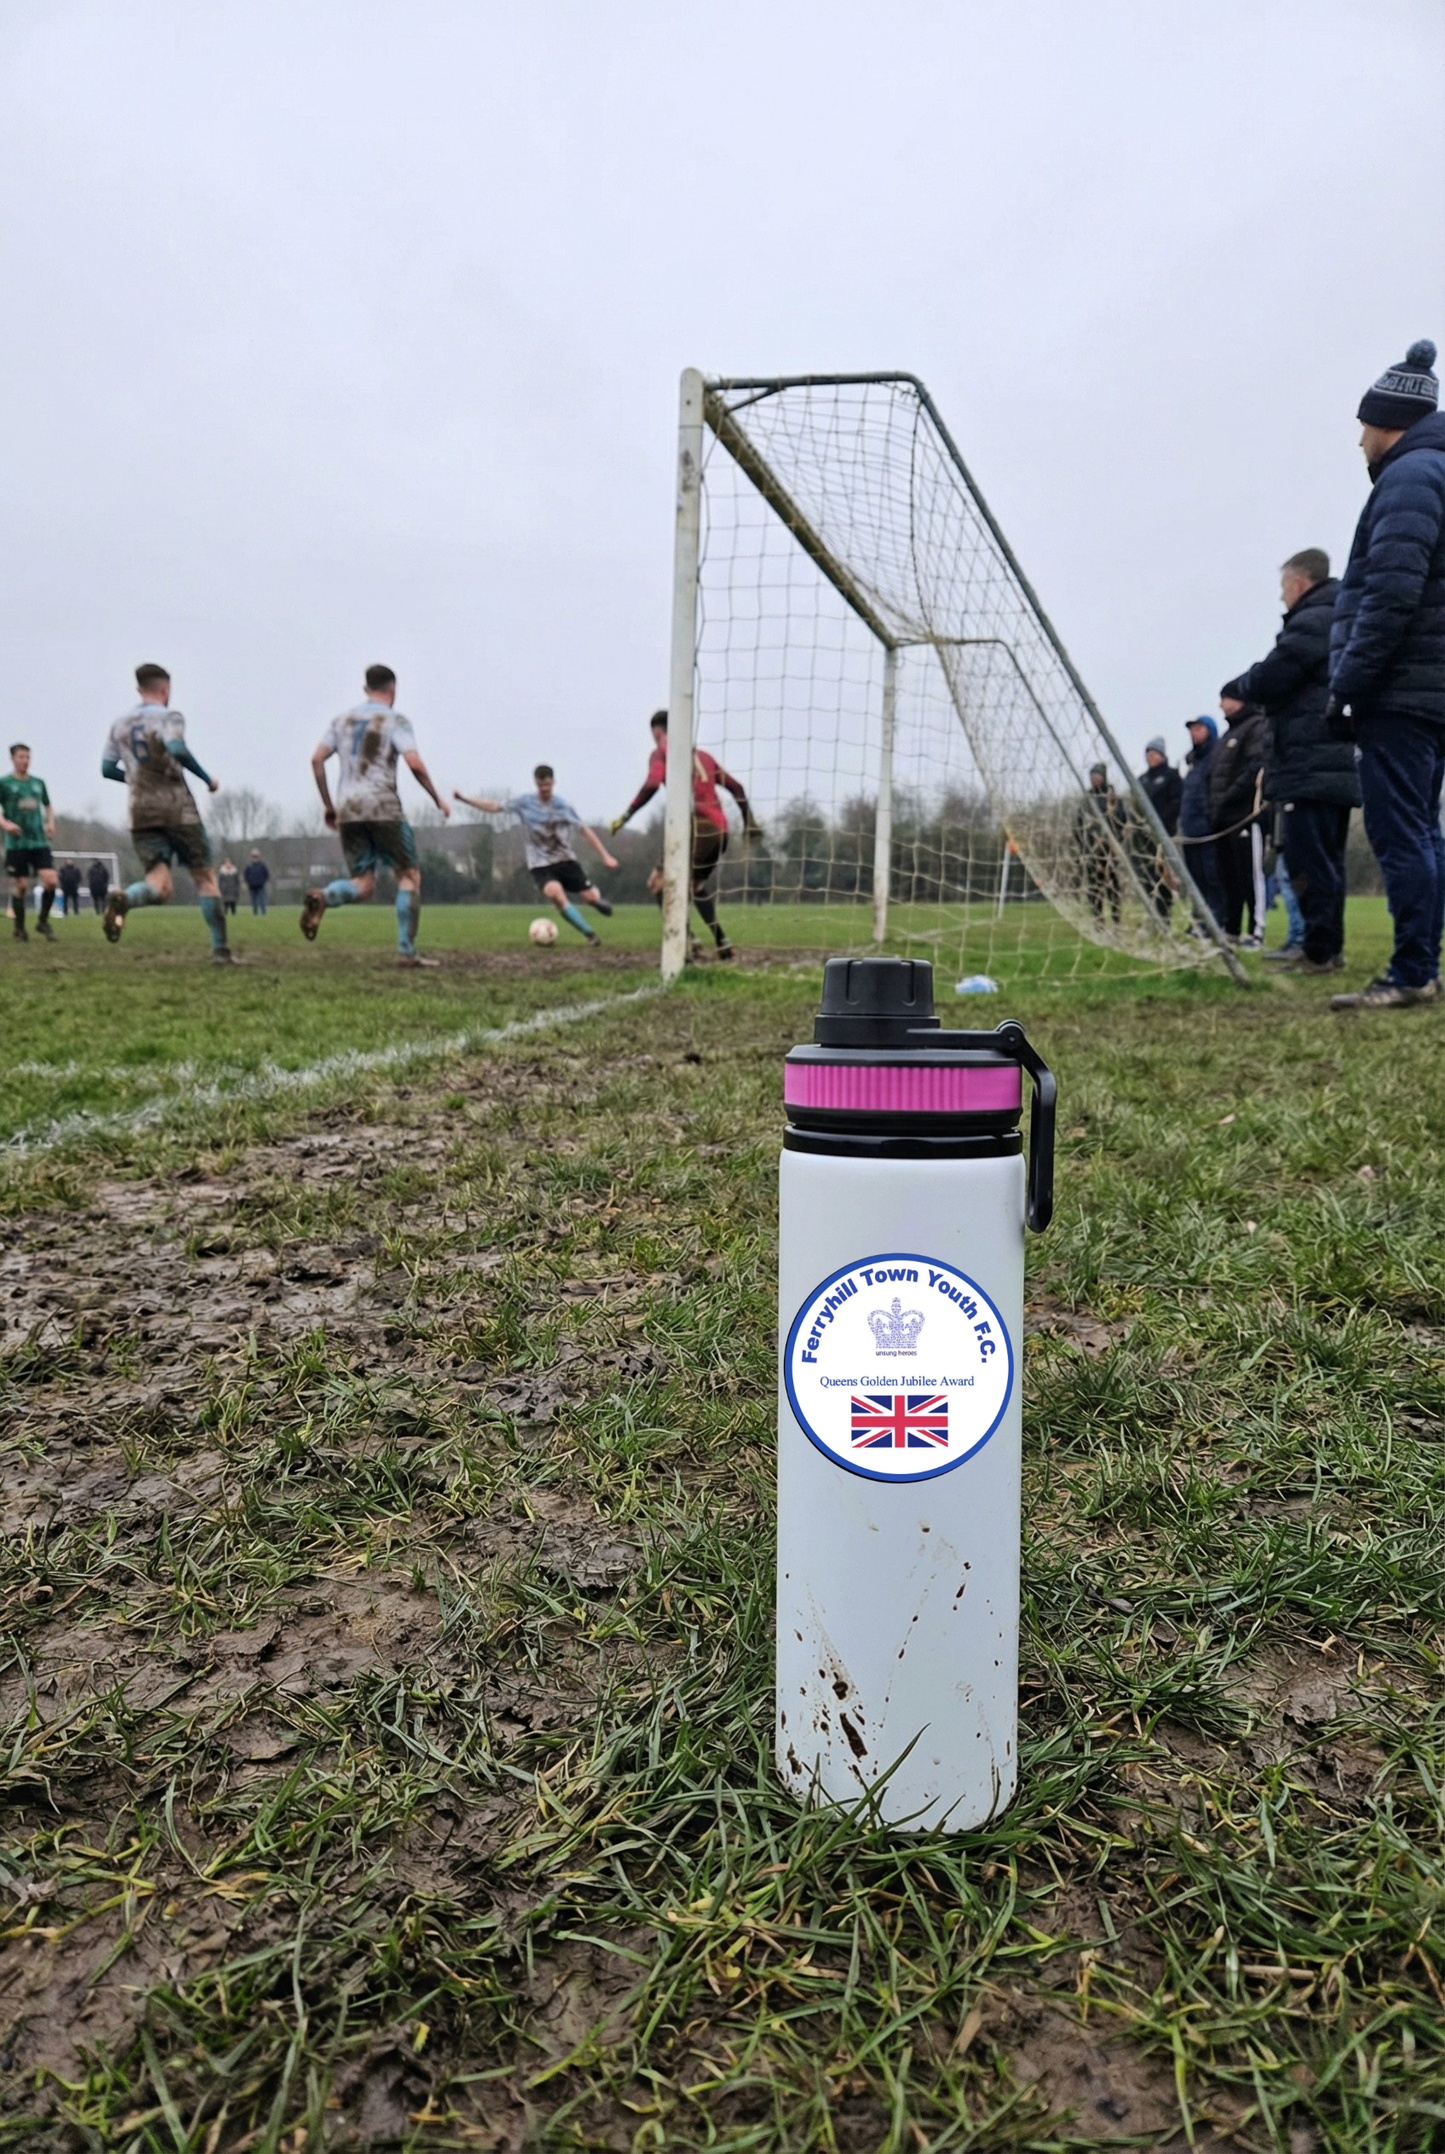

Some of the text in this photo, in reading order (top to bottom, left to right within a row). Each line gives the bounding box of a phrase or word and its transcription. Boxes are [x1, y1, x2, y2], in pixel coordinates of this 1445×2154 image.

[802, 1269, 996, 1363] Ferryhill Town Youth F.C.
[876, 1350, 897, 1358] unsung
[820, 1376, 975, 1387] Queens Golden Jubilee Award
